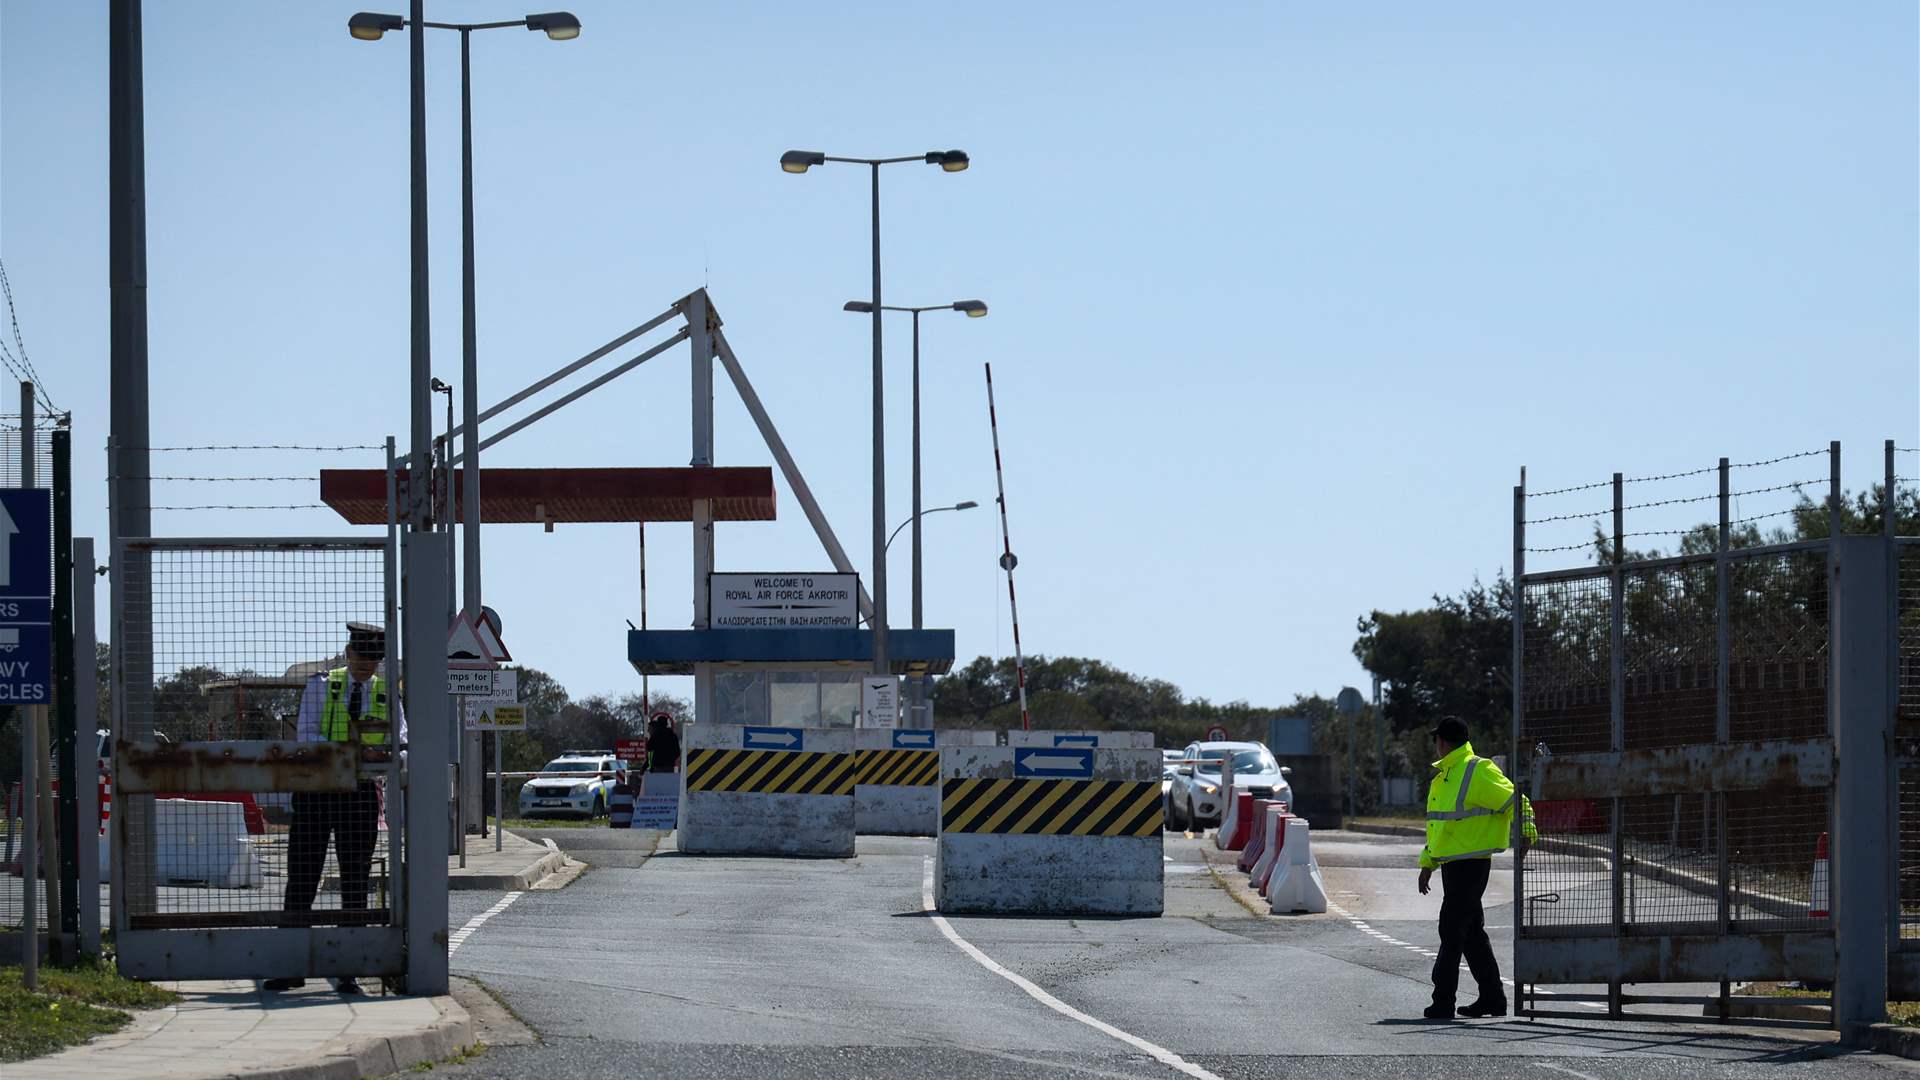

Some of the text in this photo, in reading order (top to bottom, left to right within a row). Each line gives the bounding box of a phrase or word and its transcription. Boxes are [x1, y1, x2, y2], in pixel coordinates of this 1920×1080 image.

[754, 578, 814, 588] WELCOME TO
[725, 590, 848, 600] ROYAL AIR FORCE AKROTIRI
[448, 673, 488, 682] mps for
[457, 683, 489, 692] meters
[501, 689, 513, 697] PUT
